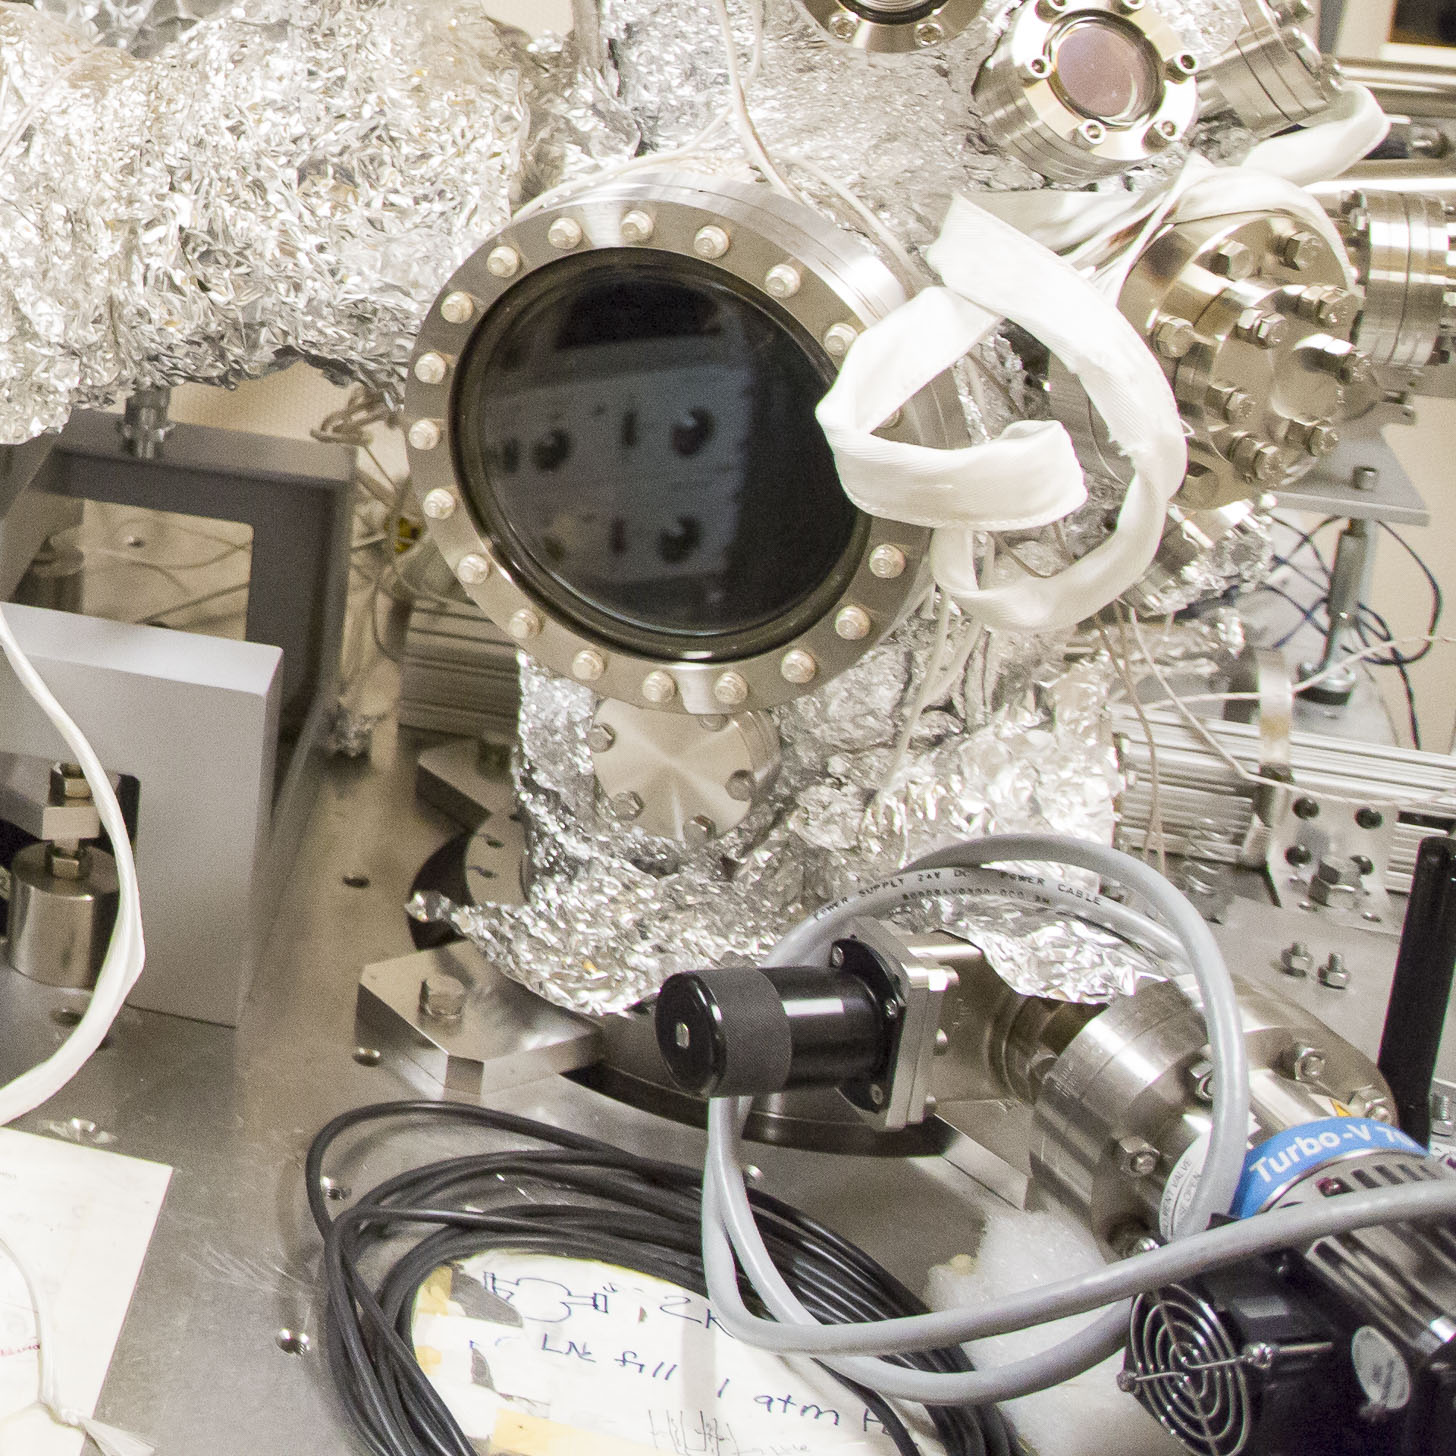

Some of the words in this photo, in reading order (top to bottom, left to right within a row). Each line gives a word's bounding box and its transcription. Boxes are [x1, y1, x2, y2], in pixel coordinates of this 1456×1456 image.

[858, 878, 906, 898] SUPPLY
[999, 871, 1046, 887] POWER
[1057, 883, 1103, 906] CABLE
[1249, 1123, 1372, 1184] Turbo-V
[753, 1394, 841, 1427] atm
